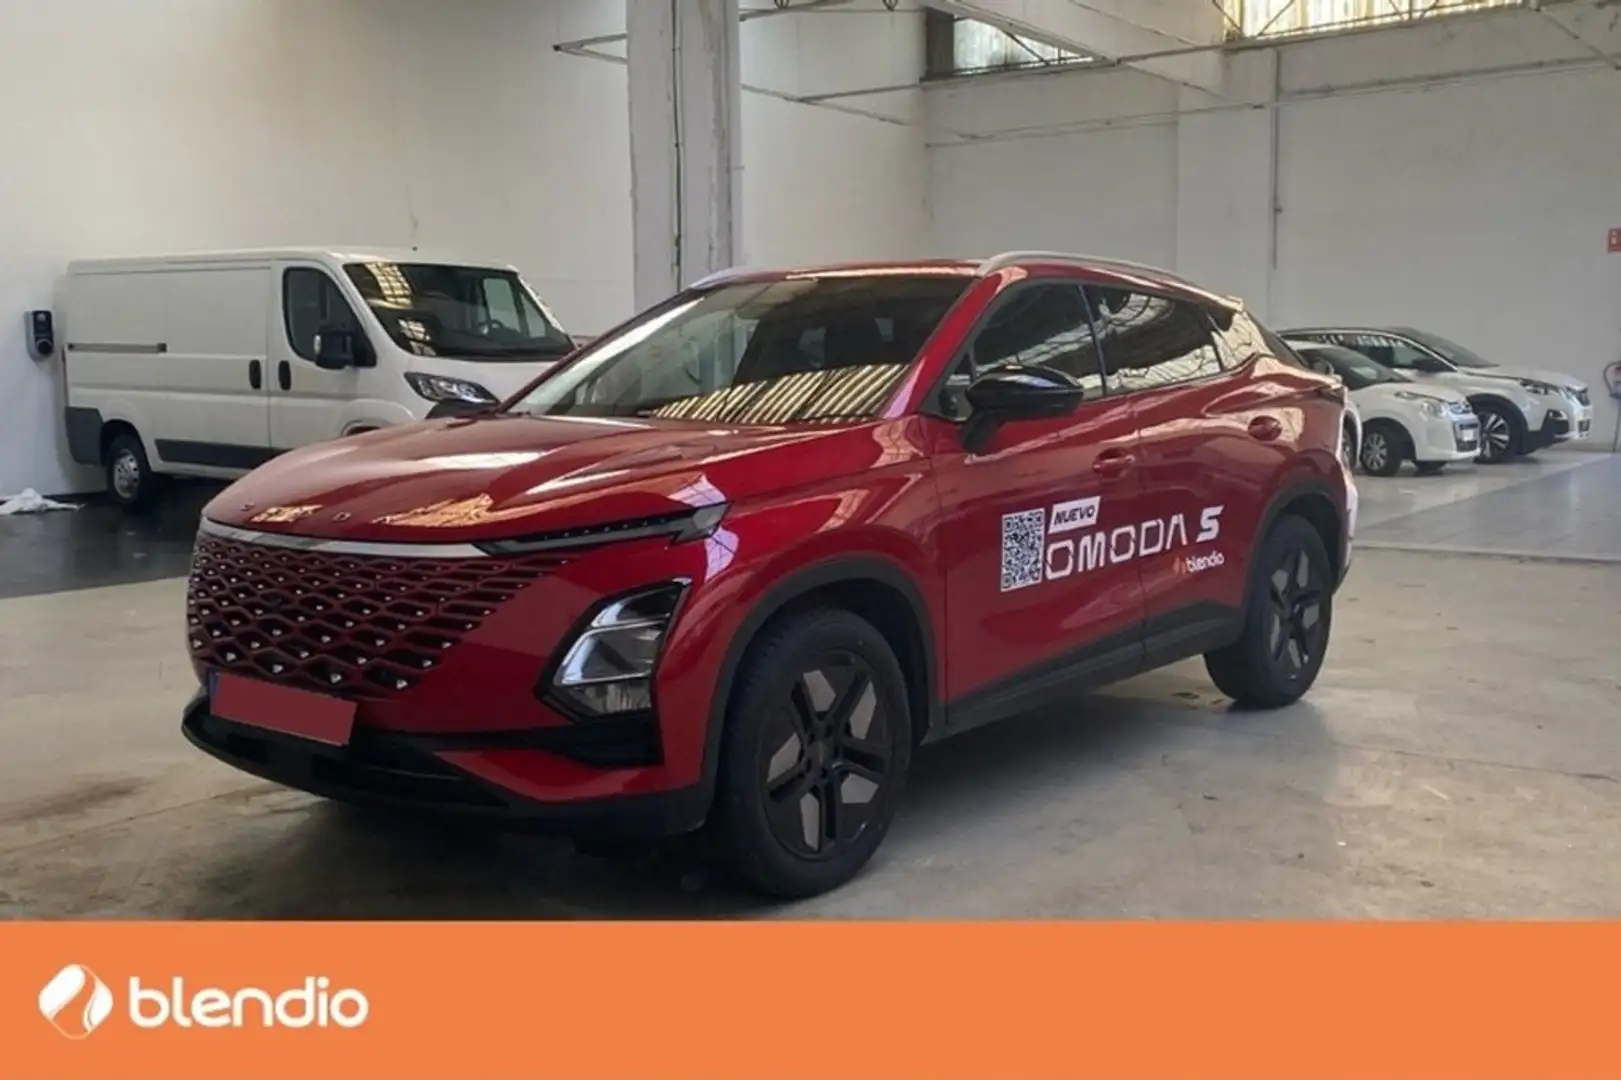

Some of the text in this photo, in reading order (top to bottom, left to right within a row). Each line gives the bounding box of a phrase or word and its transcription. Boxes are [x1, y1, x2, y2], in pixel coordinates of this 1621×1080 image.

[1054, 504, 1096, 526] NUEVO
[1045, 505, 1224, 581] OMODA 5
[1185, 550, 1225, 573] blendio
